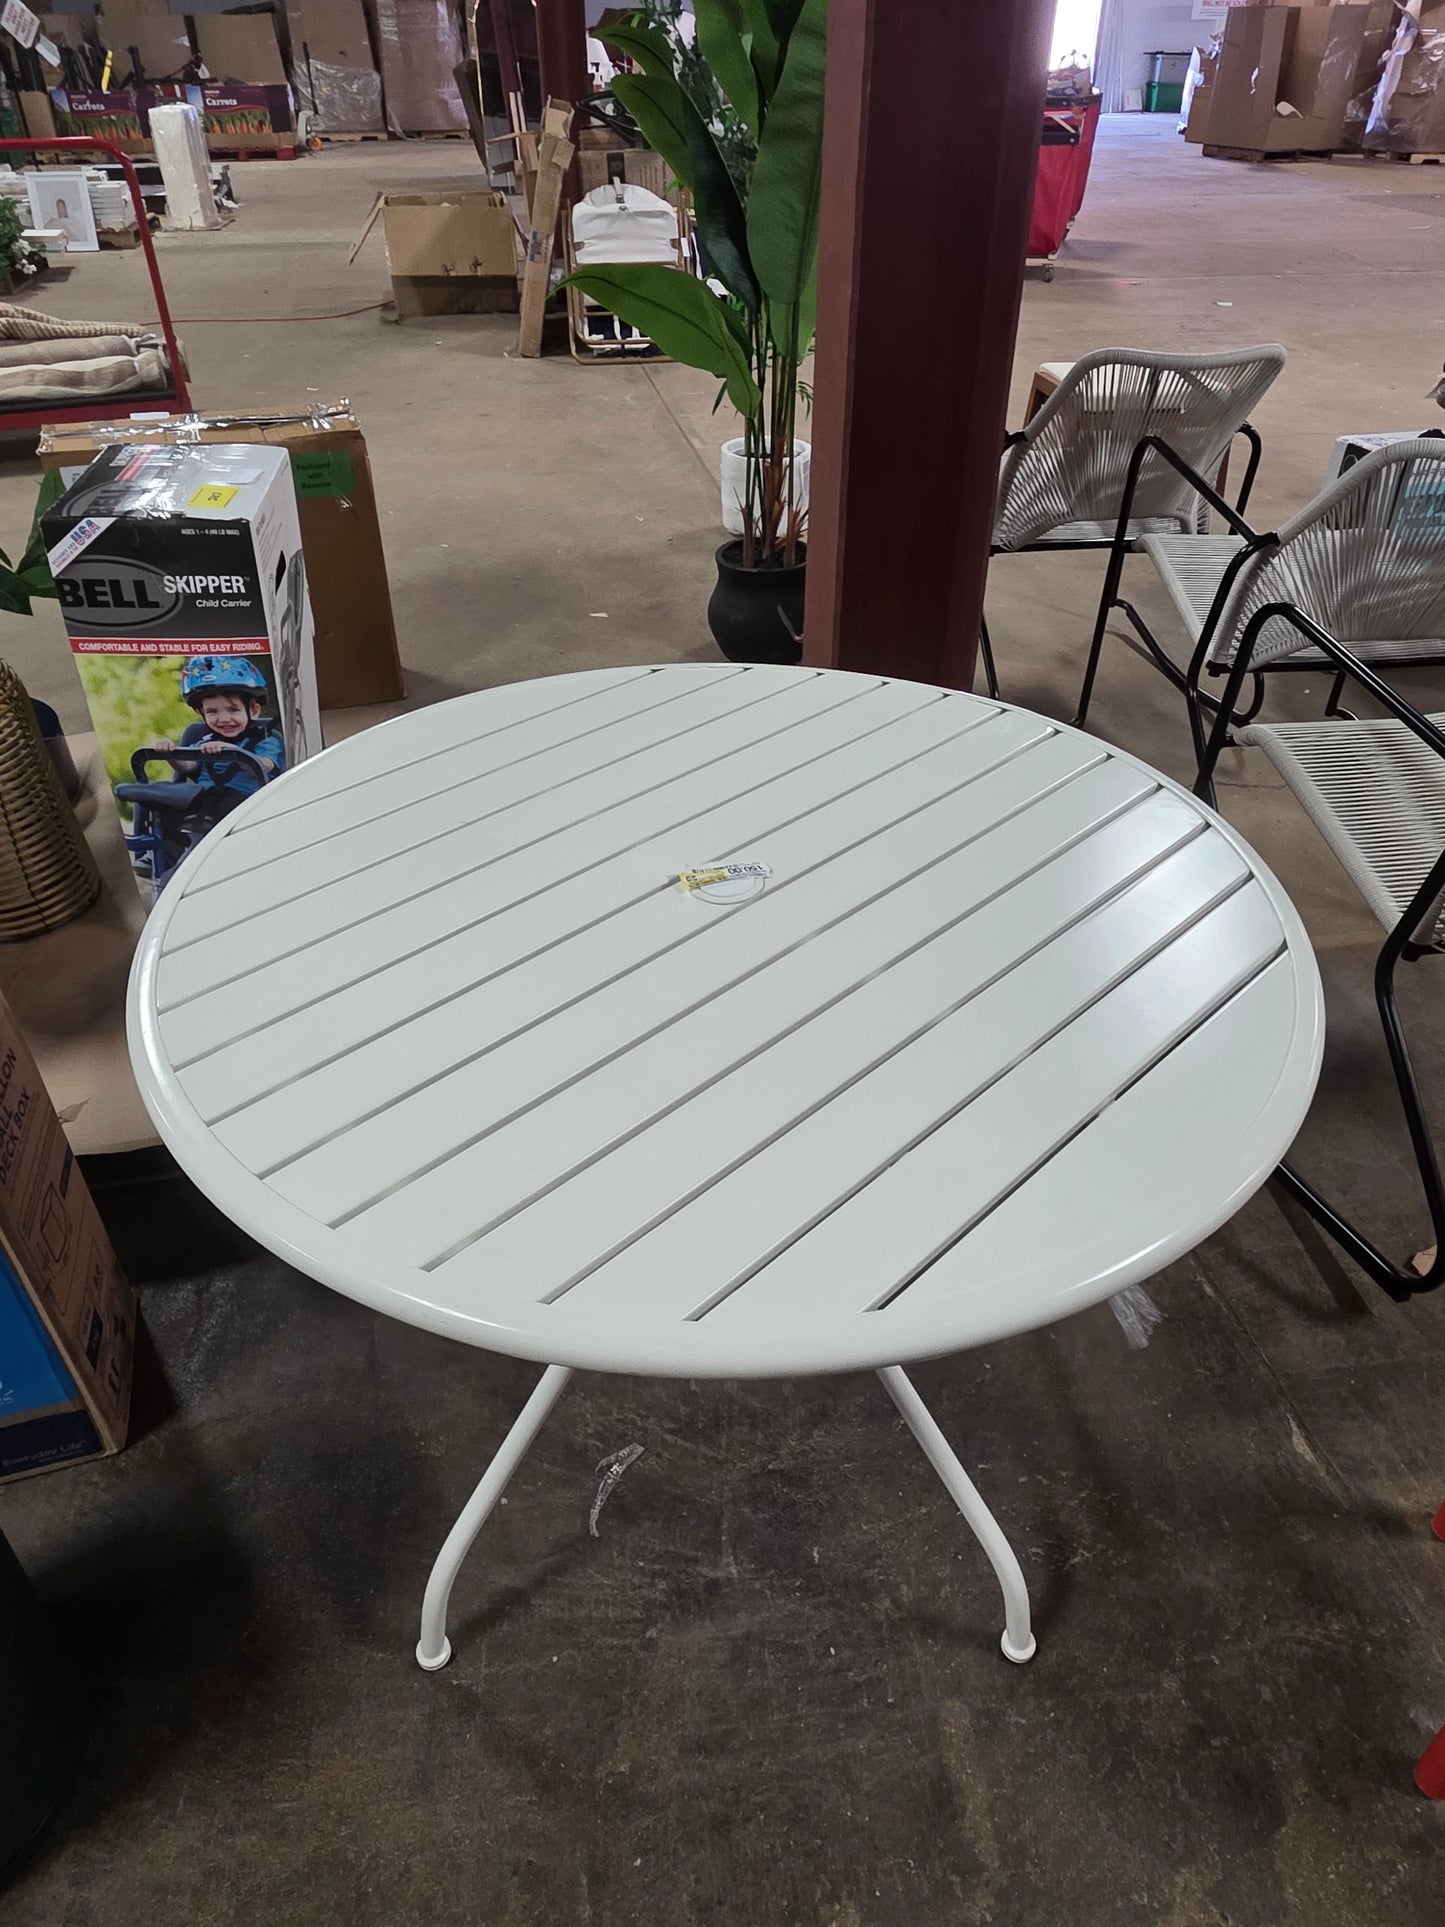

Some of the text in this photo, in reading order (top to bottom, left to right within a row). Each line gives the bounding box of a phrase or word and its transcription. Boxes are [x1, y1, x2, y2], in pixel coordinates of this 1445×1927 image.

[72, 102, 105, 111] Carrots
[206, 98, 238, 106] Carrots
[70, 519, 101, 546] USA
[163, 575, 246, 594] SKIPPER
[57, 578, 161, 609] BELL
[195, 599, 252, 608] Child Carrier
[78, 642, 139, 652] COMFORTABLE
[140, 643, 158, 652] AND
[159, 643, 190, 652] STABLE
[191, 643, 209, 652] FOR
[209, 643, 231, 652] EASY
[728, 864, 763, 876] 150.00
[0, 1127, 19, 1187] DECK
[13, 1086, 31, 1131] BOX
[3, 1449, 57, 1467] Everyday
[59, 1441, 83, 1453] Life
